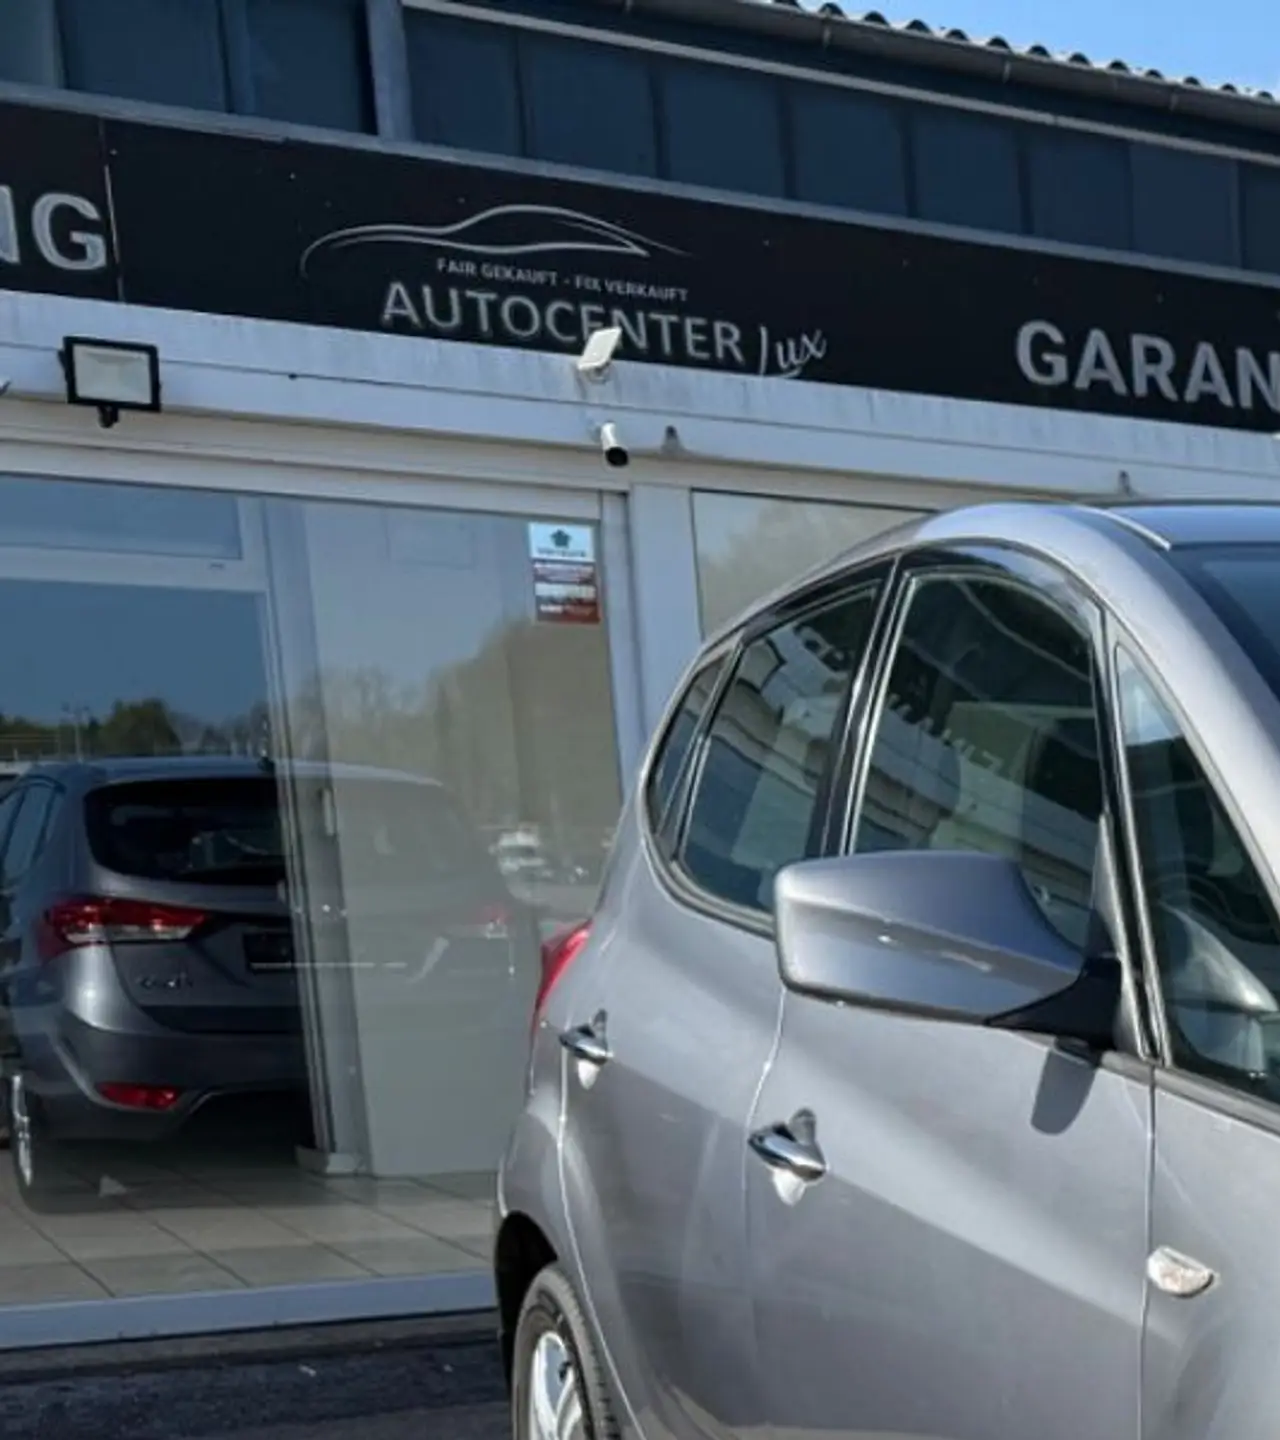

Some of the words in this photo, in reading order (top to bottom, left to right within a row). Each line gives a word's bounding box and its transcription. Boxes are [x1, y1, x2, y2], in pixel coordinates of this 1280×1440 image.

[438, 257, 477, 276] FAIR
[482, 261, 557, 287] GEKAUFT
[605, 279, 689, 302] VERKAUFT
[381, 282, 746, 364] AUTOCENTER
